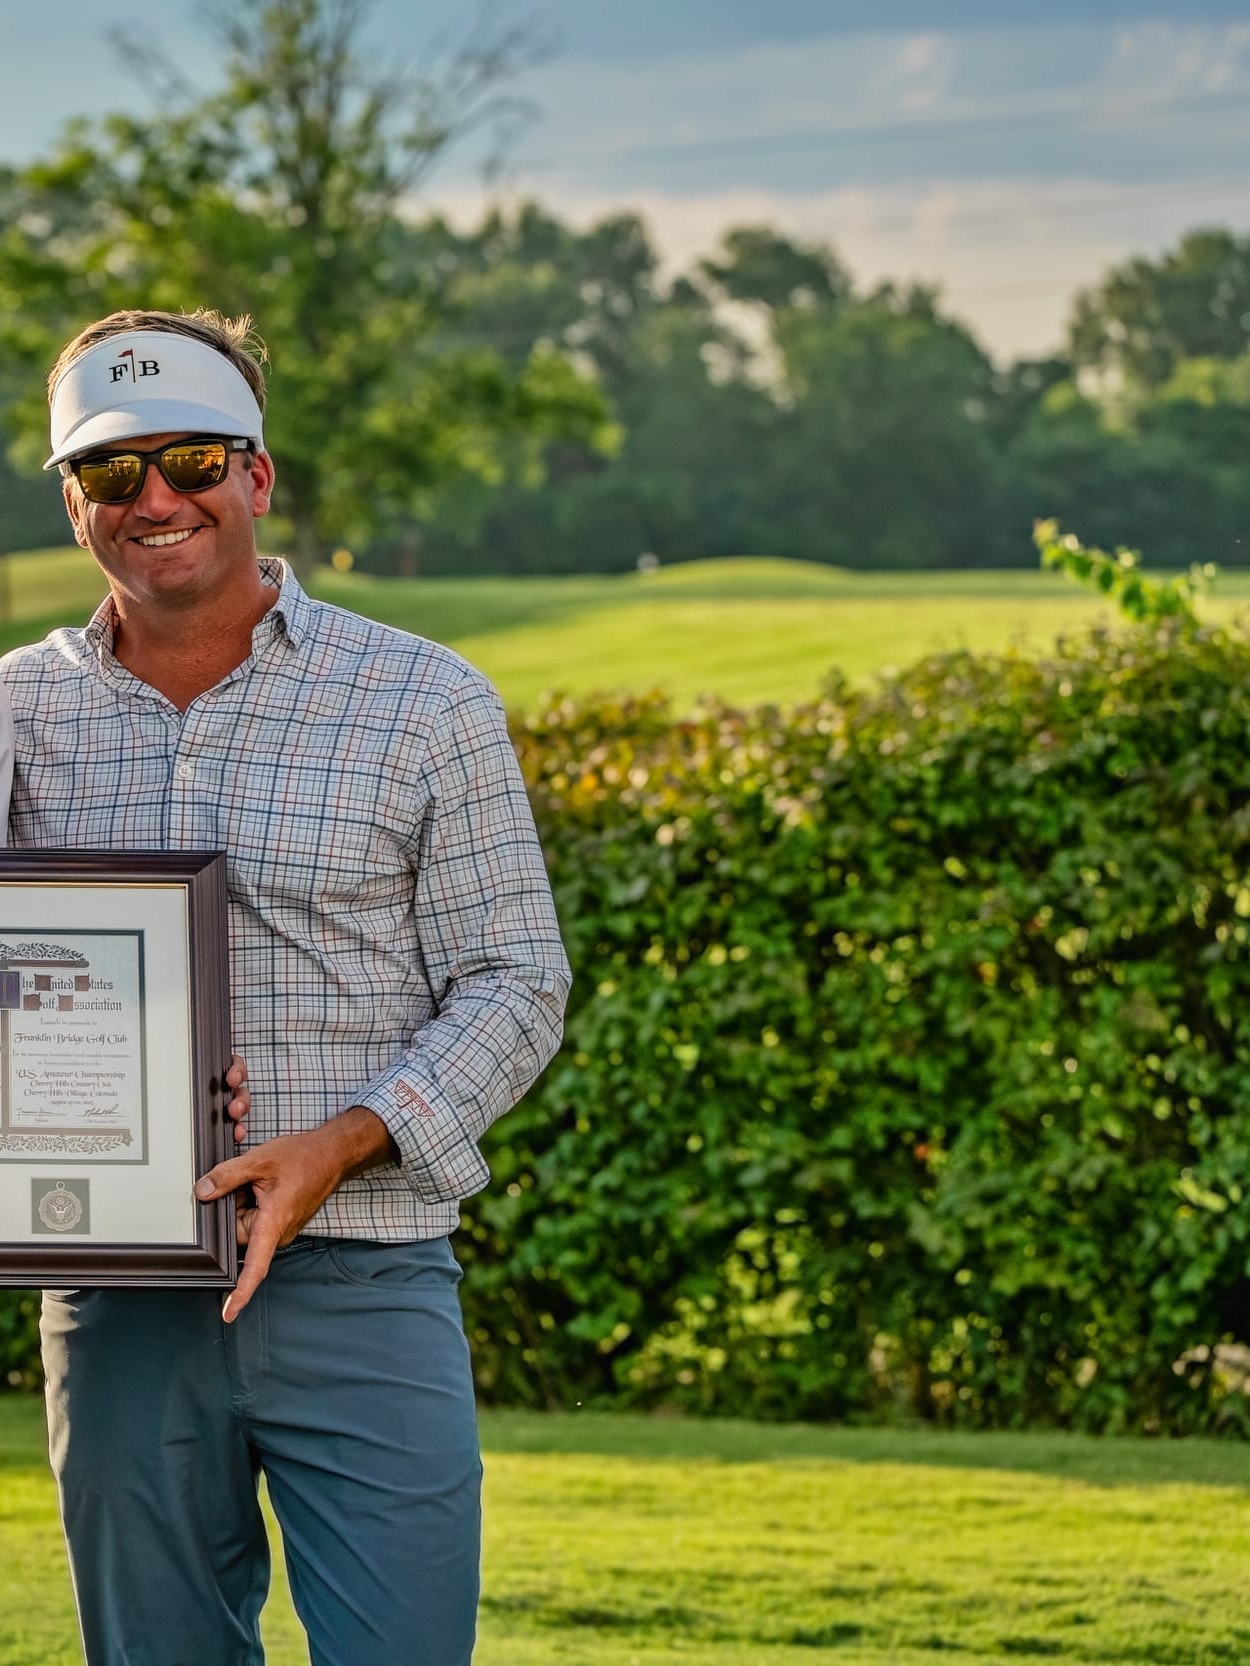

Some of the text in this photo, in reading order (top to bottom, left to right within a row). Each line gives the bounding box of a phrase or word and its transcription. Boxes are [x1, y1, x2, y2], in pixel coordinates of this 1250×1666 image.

[56, 994, 122, 1011] ssociation
[53, 1033, 84, 1046] Bridge
[86, 1033, 107, 1047] Golf
